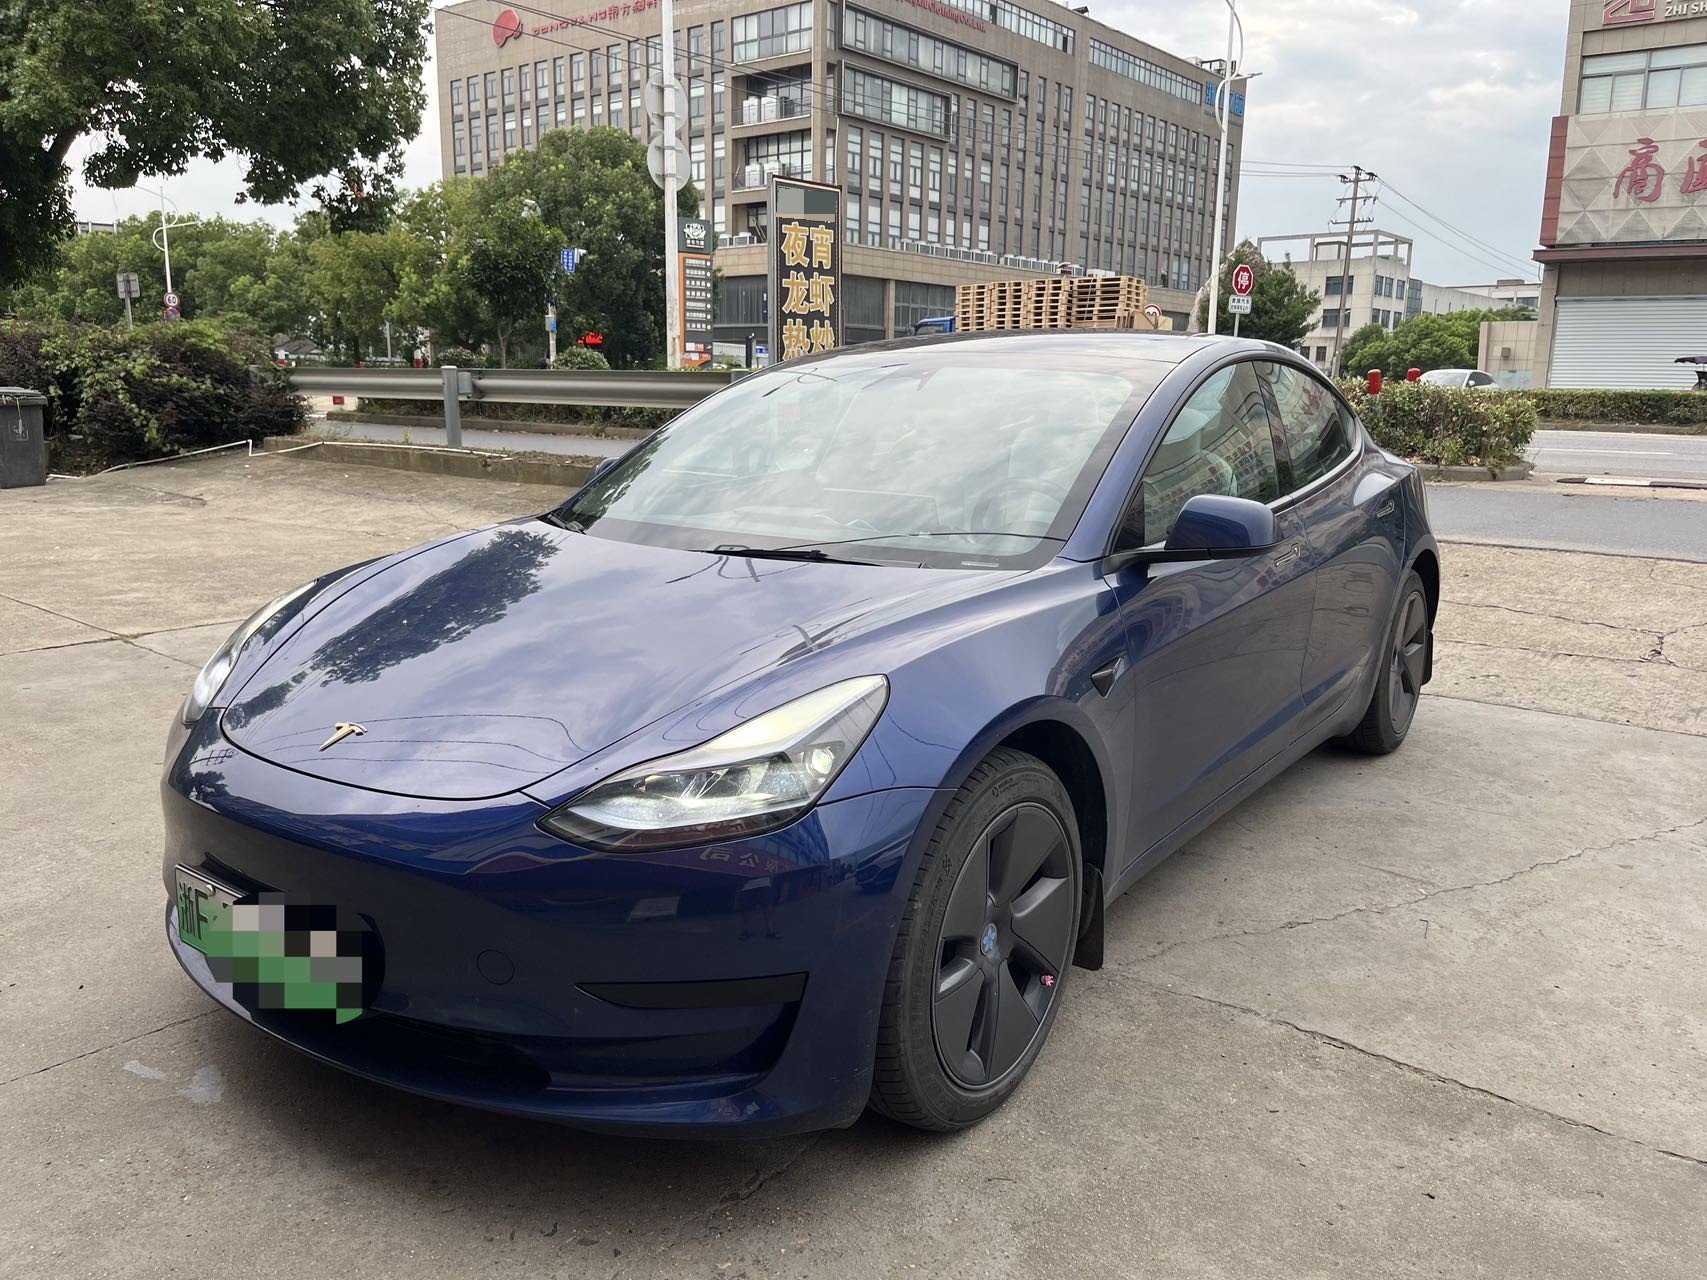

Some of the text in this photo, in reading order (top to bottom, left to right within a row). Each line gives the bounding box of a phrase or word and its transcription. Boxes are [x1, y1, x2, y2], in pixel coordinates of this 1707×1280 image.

[1665, 4, 1689, 17] ZHI
[781, 222, 834, 269] 夜宵
[782, 271, 835, 317] 龙虾
[1238, 271, 1249, 289] 停
[168, 296, 177, 304] 60
[783, 319, 835, 361] 热炒
